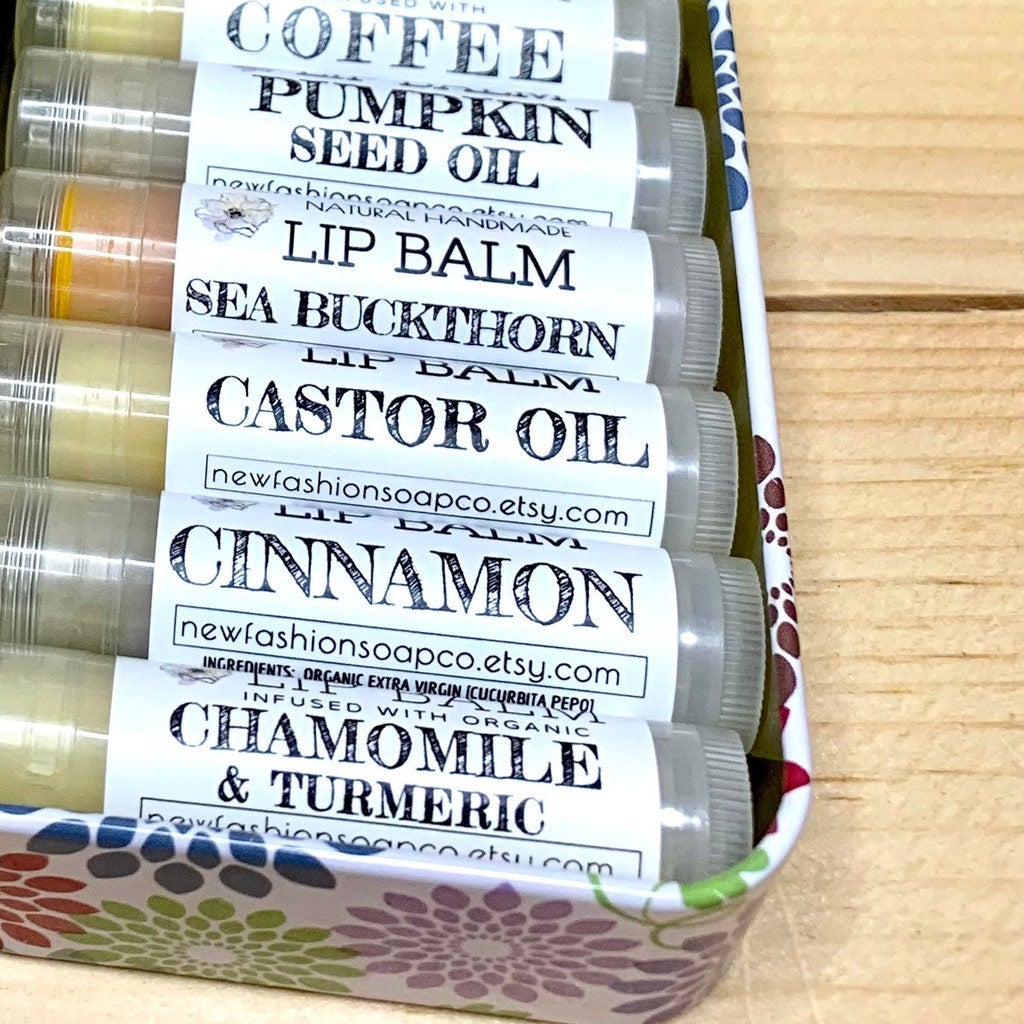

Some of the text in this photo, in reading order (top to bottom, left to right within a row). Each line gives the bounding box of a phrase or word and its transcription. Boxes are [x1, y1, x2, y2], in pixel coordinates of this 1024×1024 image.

[226, 0, 565, 83] COFFEE
[430, 0, 486, 15] WITH
[250, 74, 598, 149] PUMPKIN
[290, 125, 540, 189] SEED OIL
[282, 219, 576, 291] LIP BALM
[306, 200, 572, 238] NATURAL HANDMADE
[185, 278, 625, 361] SEA BUCKTHORN
[205, 375, 650, 468] CASTOR OIL
[212, 465, 629, 527] newfashionsoapco.etsy.com
[168, 524, 643, 634] CINNAMON
[180, 617, 620, 687] newfashionsoapco.etsy.com
[303, 667, 364, 687] ORGANIC
[367, 675, 410, 692] EXTRA
[415, 680, 462, 698] VIRGIN
[168, 701, 602, 791] CHAMOMILE
[243, 691, 591, 737] INFUSED WITH ORGANIC
[217, 764, 546, 836] & TURMERIC
